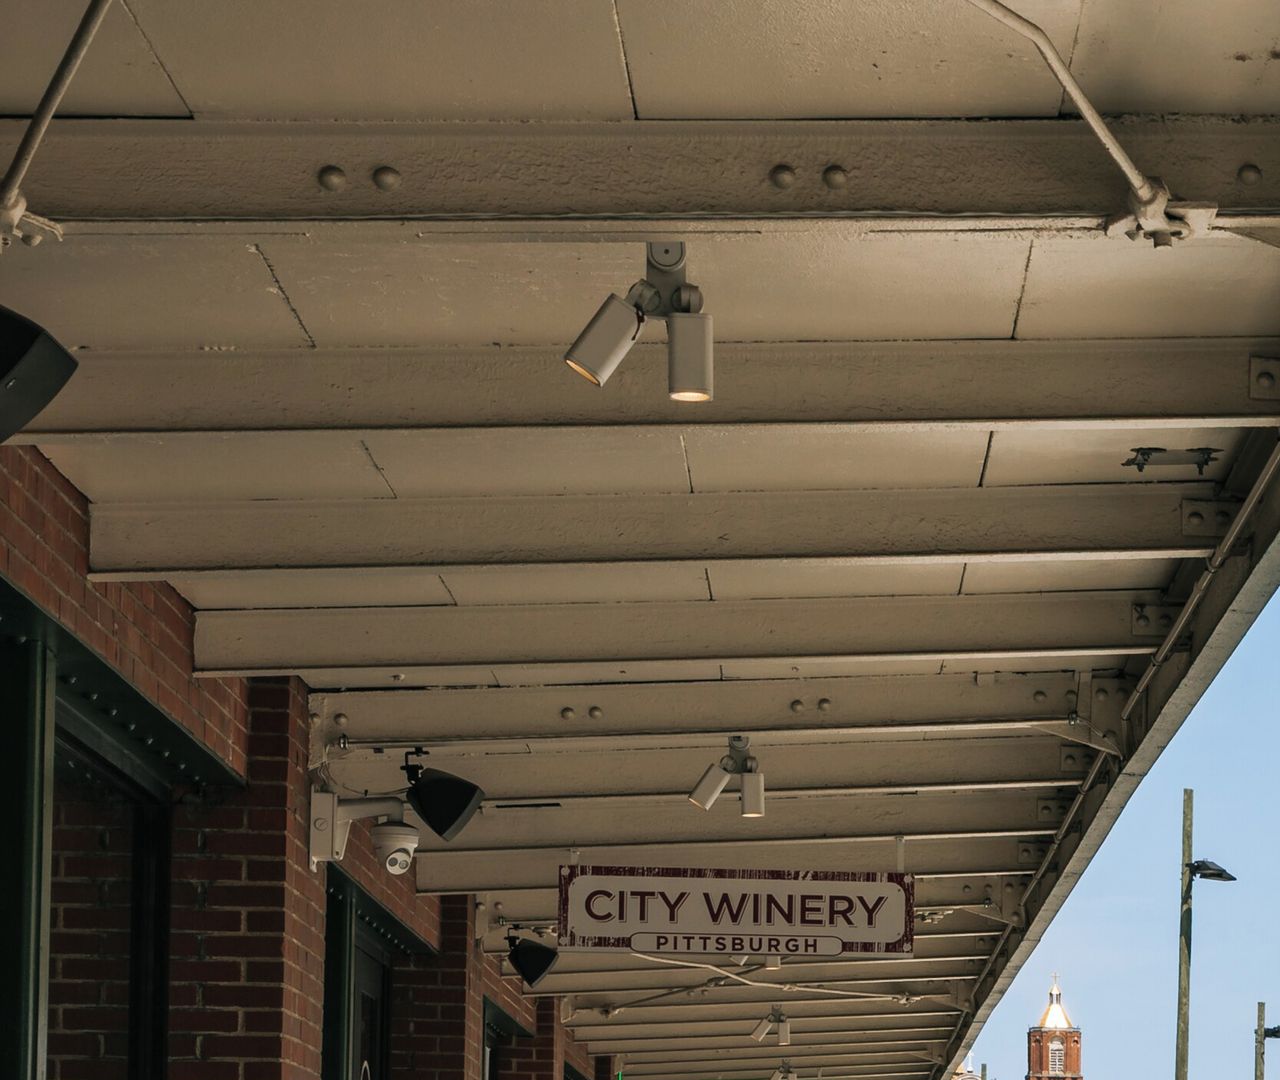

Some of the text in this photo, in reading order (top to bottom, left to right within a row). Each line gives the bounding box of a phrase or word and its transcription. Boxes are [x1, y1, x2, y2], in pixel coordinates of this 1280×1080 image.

[584, 889, 889, 929] CITY WINERY
[656, 935, 818, 954] PITTSBURGH
